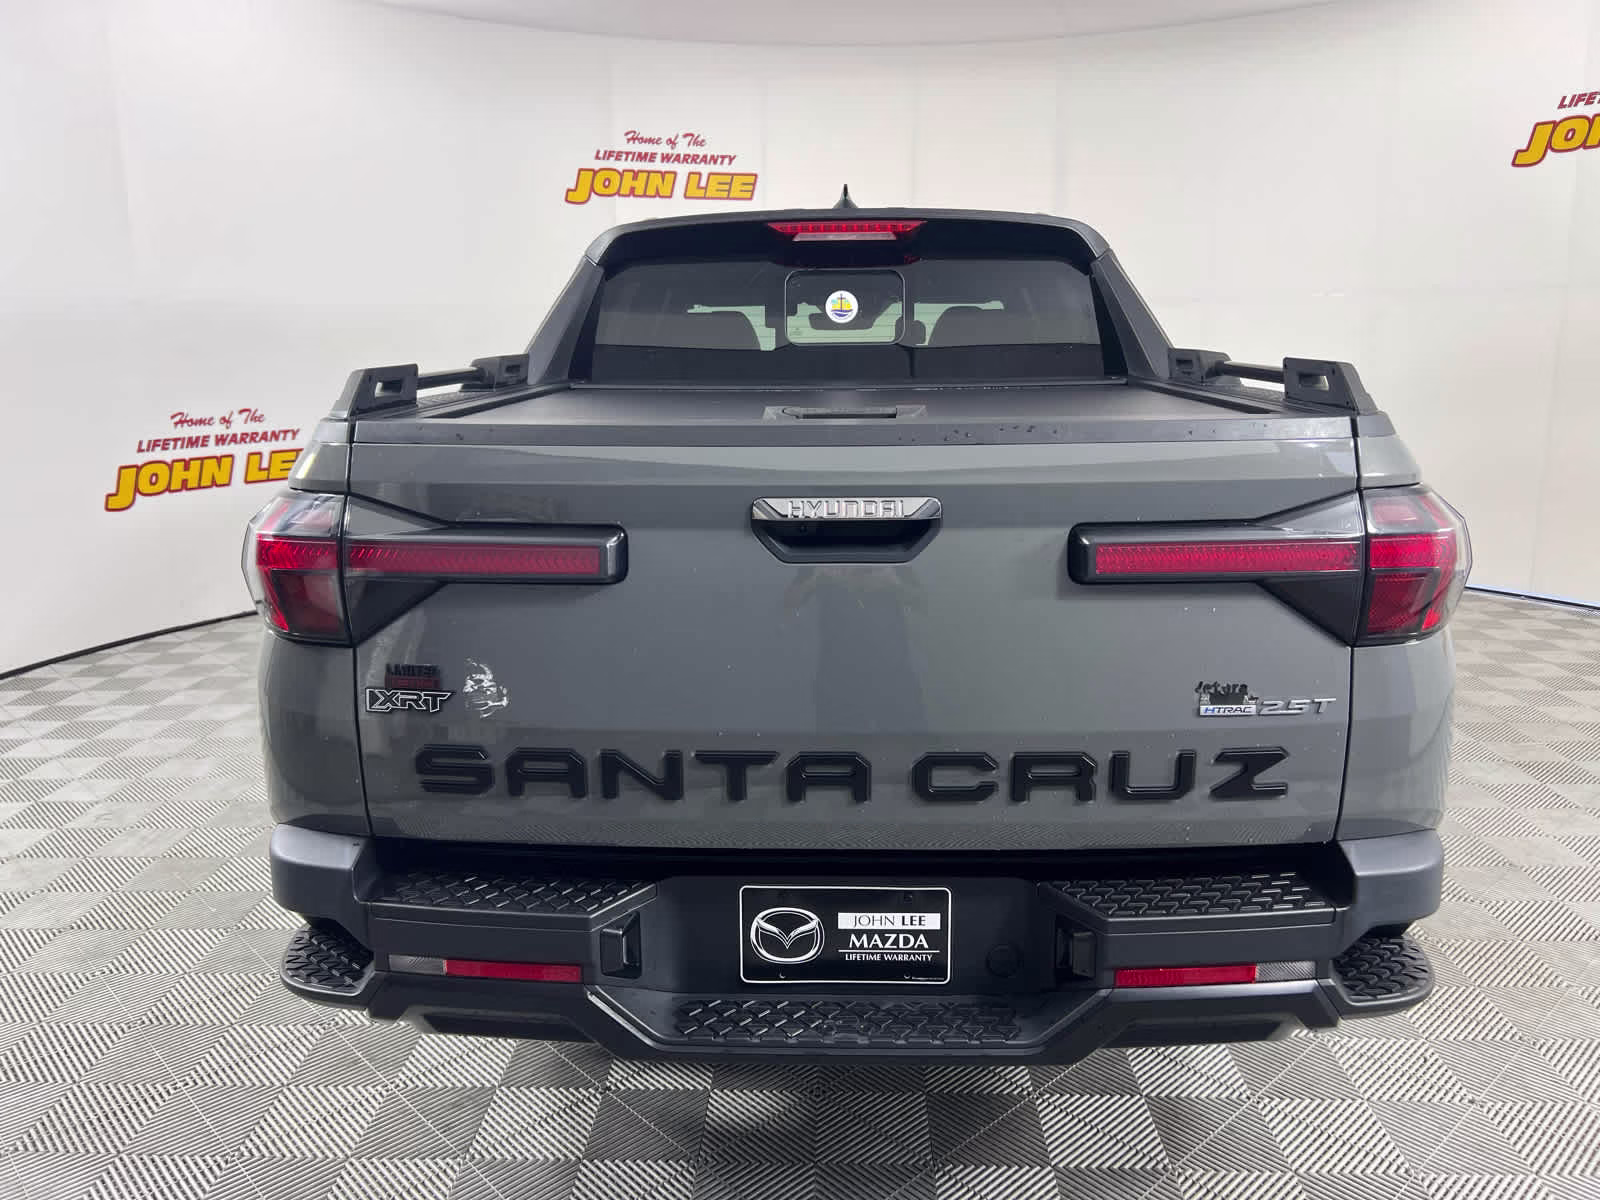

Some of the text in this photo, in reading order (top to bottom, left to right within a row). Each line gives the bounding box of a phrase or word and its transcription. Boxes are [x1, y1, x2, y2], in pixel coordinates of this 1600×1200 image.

[624, 130, 707, 149] Home of The
[594, 149, 737, 166] LIFETIME WARRANTY
[564, 167, 758, 206] JOHN LEE
[170, 408, 265, 429] Home of The
[136, 428, 301, 453] LIFETIME WARRANTY
[104, 448, 304, 513] JOHN LE
[787, 500, 905, 519] HYUNDAI
[366, 687, 453, 712] XRT
[1204, 706, 1252, 714] HTRAC
[415, 744, 1290, 803] SANTA CRUZ
[854, 914, 926, 928] JOHN LEE
[849, 933, 929, 949] MAZDA
[884, 954, 933, 962] WARRANTY
